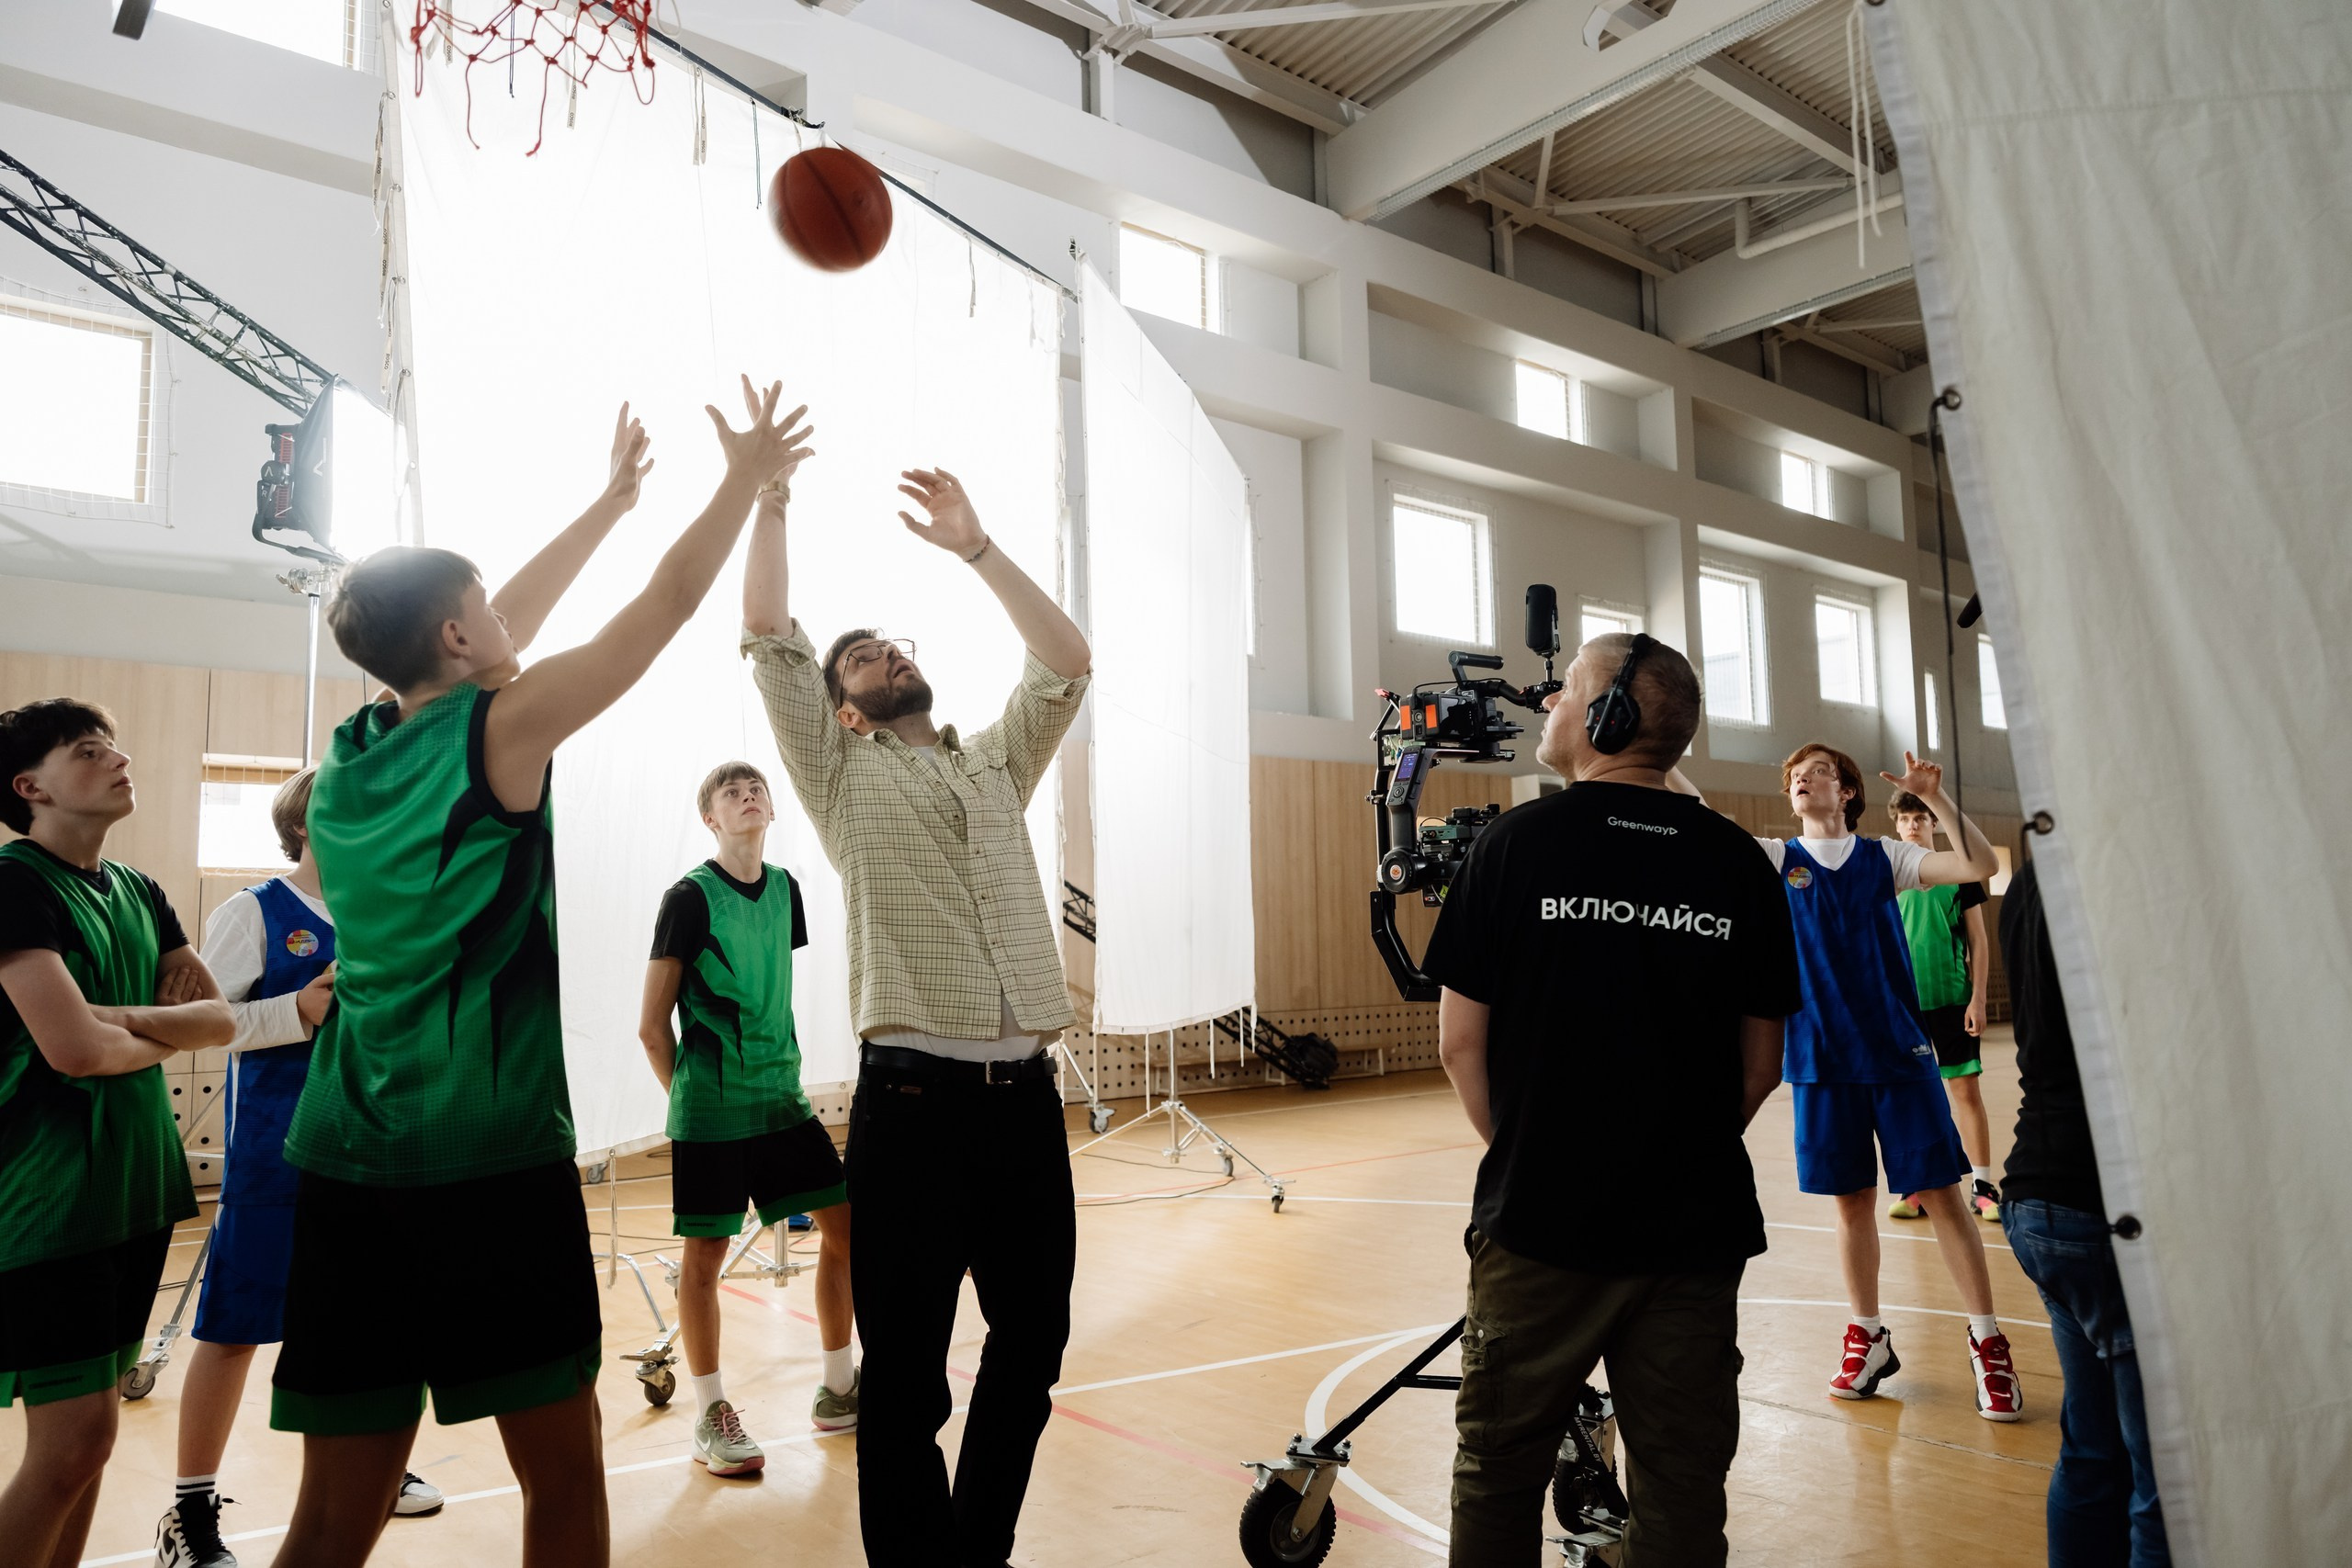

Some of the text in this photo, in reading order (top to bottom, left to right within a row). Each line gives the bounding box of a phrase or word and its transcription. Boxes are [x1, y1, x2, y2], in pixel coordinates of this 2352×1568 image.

[1607, 816, 1669, 836] Greenway
[1541, 897, 1732, 941] ВКЛЮЧАЙСЯ
[1573, 1416, 1602, 1462] MYRENTAL.BY
